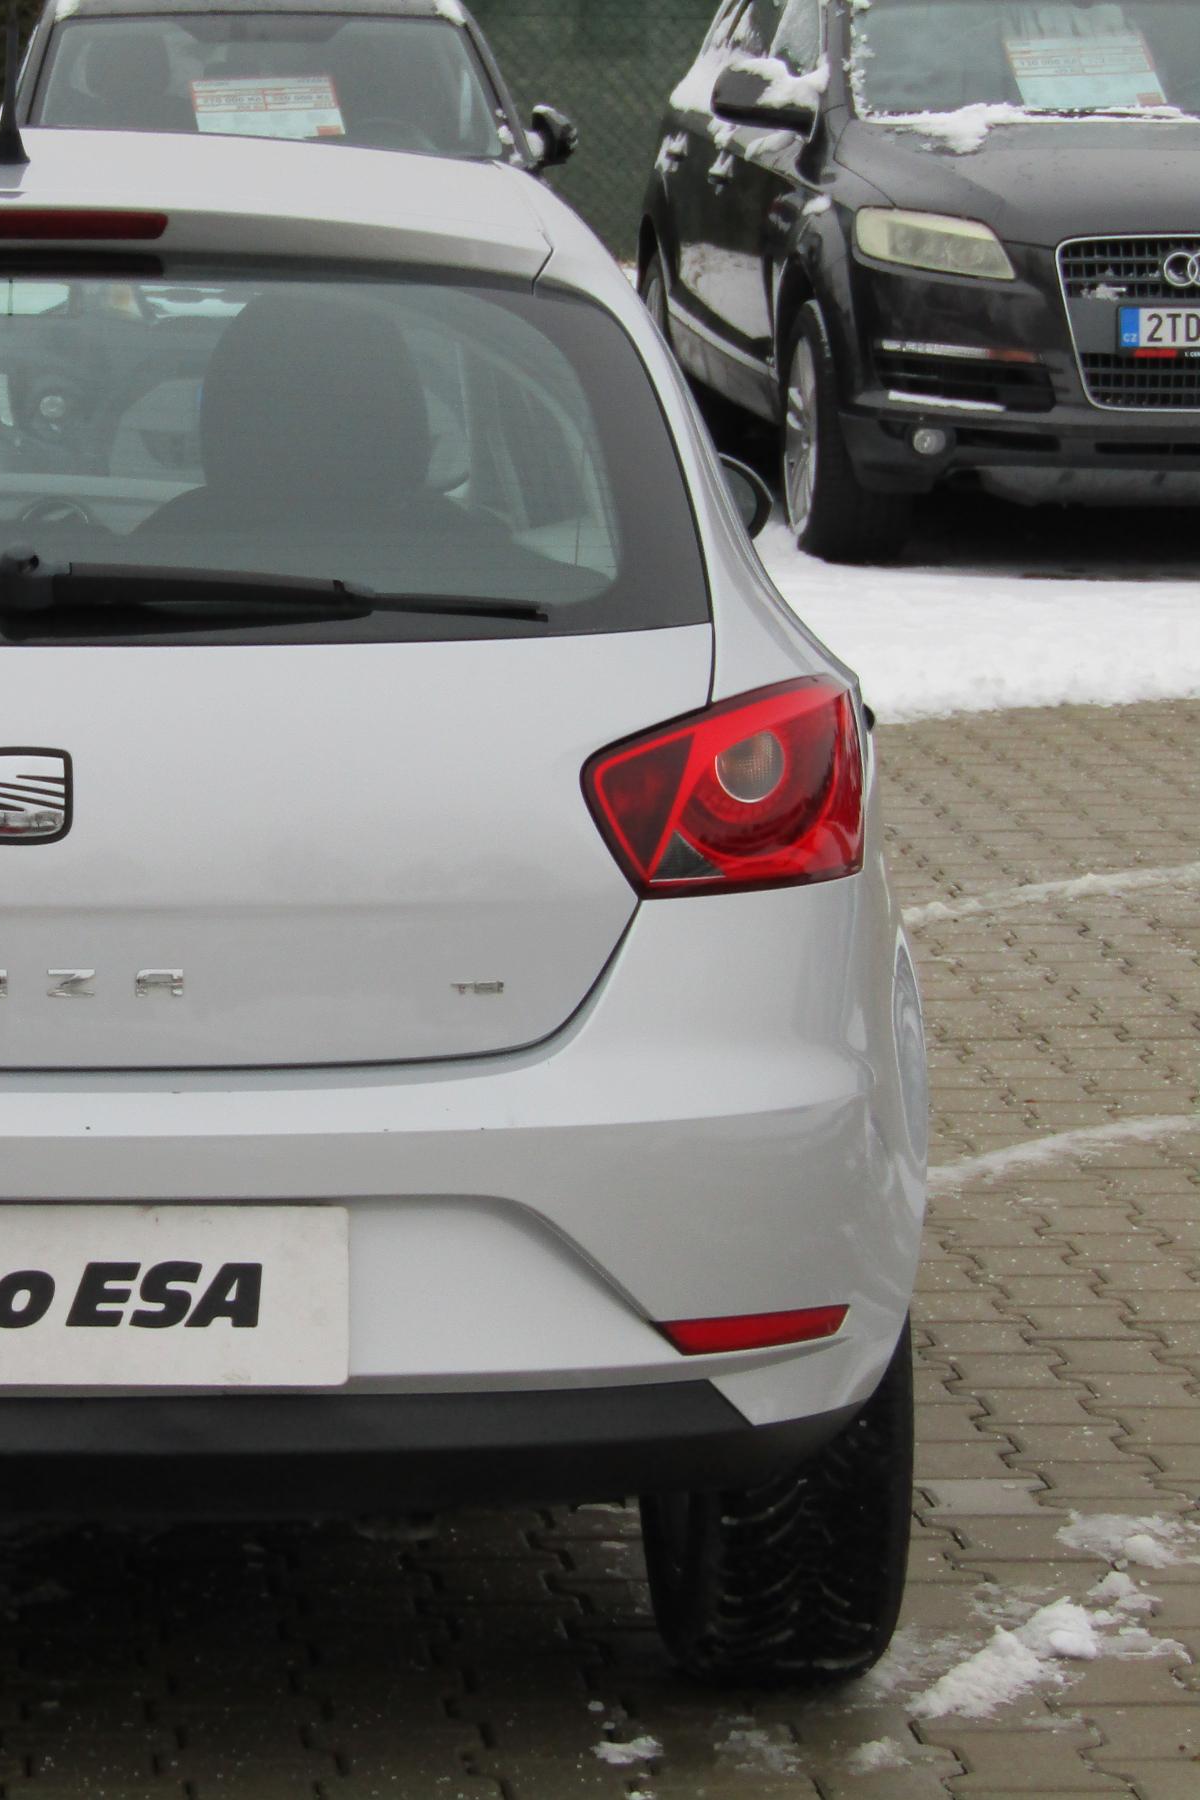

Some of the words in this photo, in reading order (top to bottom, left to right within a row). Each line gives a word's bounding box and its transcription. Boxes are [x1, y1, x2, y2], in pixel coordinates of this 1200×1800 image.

[1123, 333, 1137, 343] CZ
[1146, 312, 1200, 342] 2TD
[65, 1260, 263, 1329] ESA
